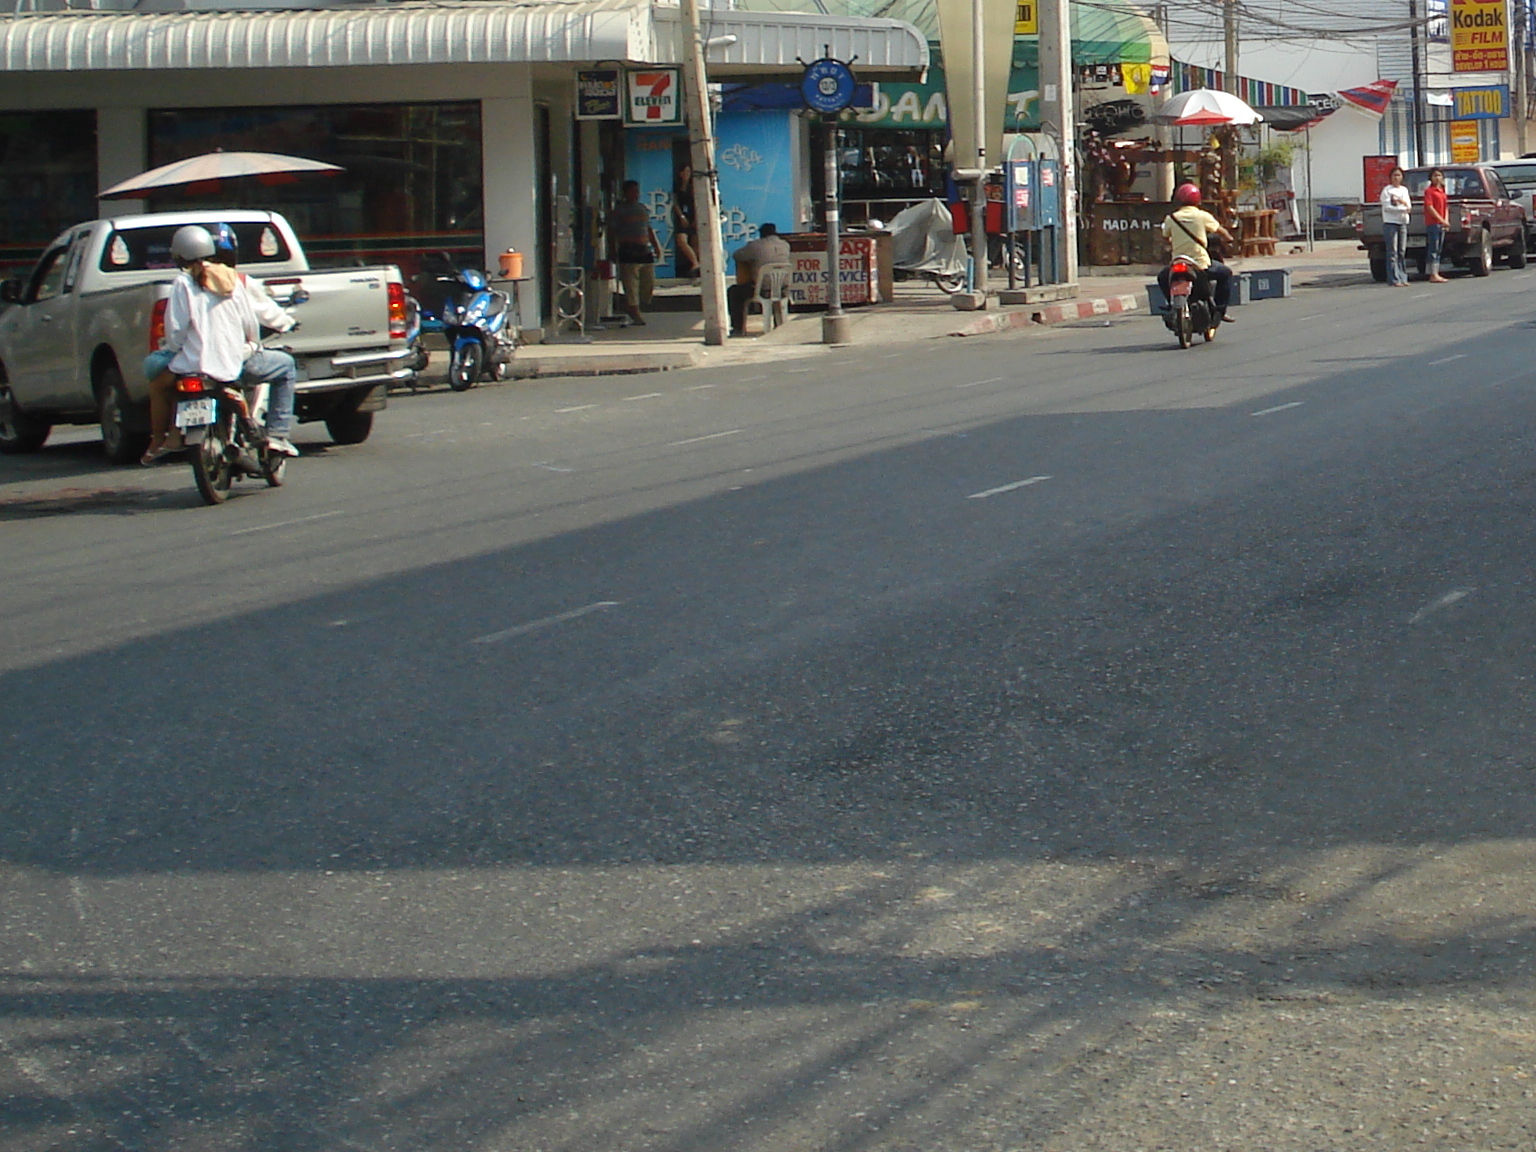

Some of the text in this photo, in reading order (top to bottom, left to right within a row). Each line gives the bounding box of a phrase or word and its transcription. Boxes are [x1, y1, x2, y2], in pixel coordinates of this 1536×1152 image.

[1453, 8, 1504, 29] Kodak
[1470, 31, 1504, 44] FILM
[1457, 90, 1502, 117] TATTOO
[839, 240, 869, 255] AR
[797, 257, 862, 270] FOR ENT
[792, 272, 817, 283] TAXI
